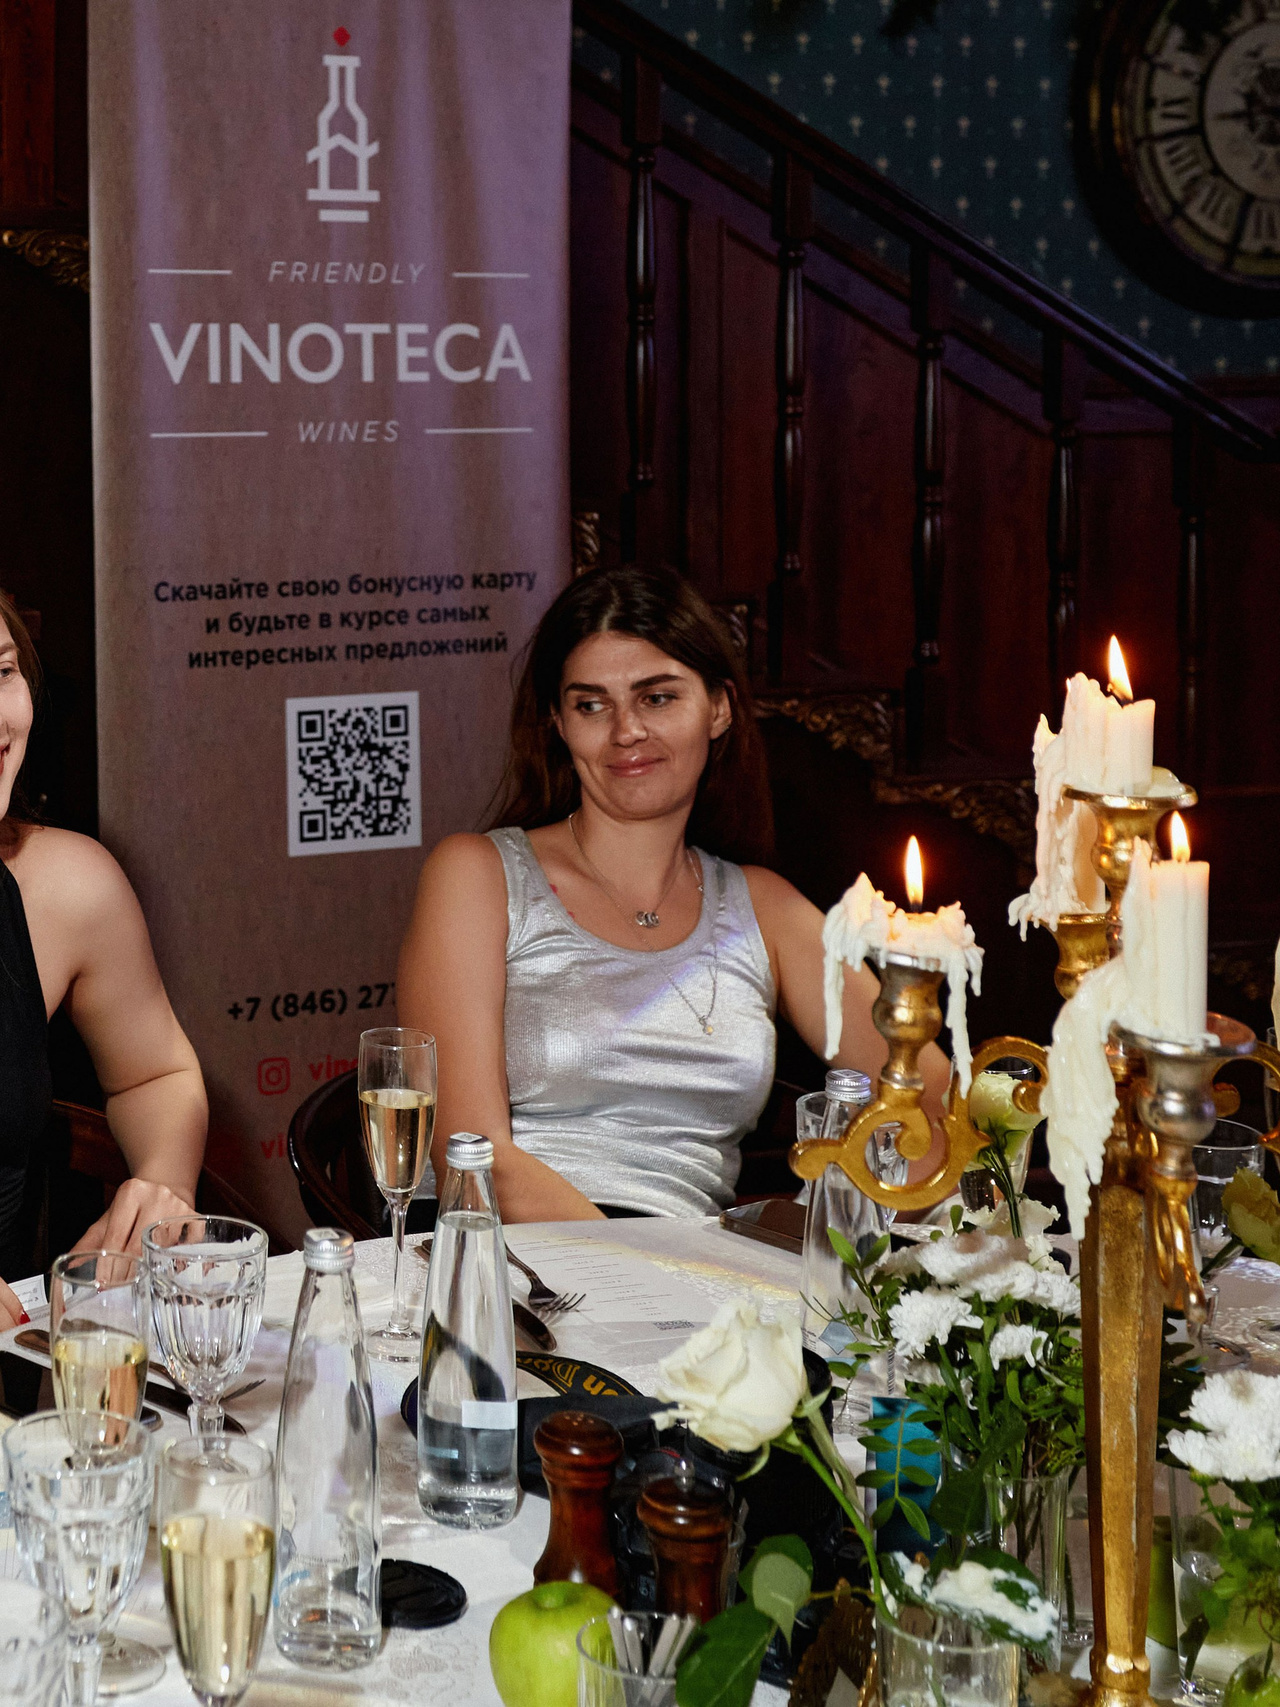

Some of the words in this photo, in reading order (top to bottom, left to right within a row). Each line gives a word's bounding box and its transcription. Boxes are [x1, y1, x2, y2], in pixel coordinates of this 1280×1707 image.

[268, 261, 426, 285] FRIENDLY
[149, 322, 532, 384] VINOTECA
[298, 420, 400, 443] WINES
[154, 577, 269, 603] Скачайте
[277, 576, 341, 598] свою
[348, 571, 463, 598] бонусную
[472, 568, 537, 593] карту
[206, 617, 219, 633] и
[228, 611, 310, 637] будьте
[319, 612, 332, 629] в
[340, 607, 409, 632] курсе
[417, 604, 490, 625] самых
[188, 645, 336, 670] интересных
[345, 632, 508, 663] предложений
[228, 996, 261, 1022] +7
[271, 987, 348, 1022] (846)
[358, 981, 396, 1010] 27
